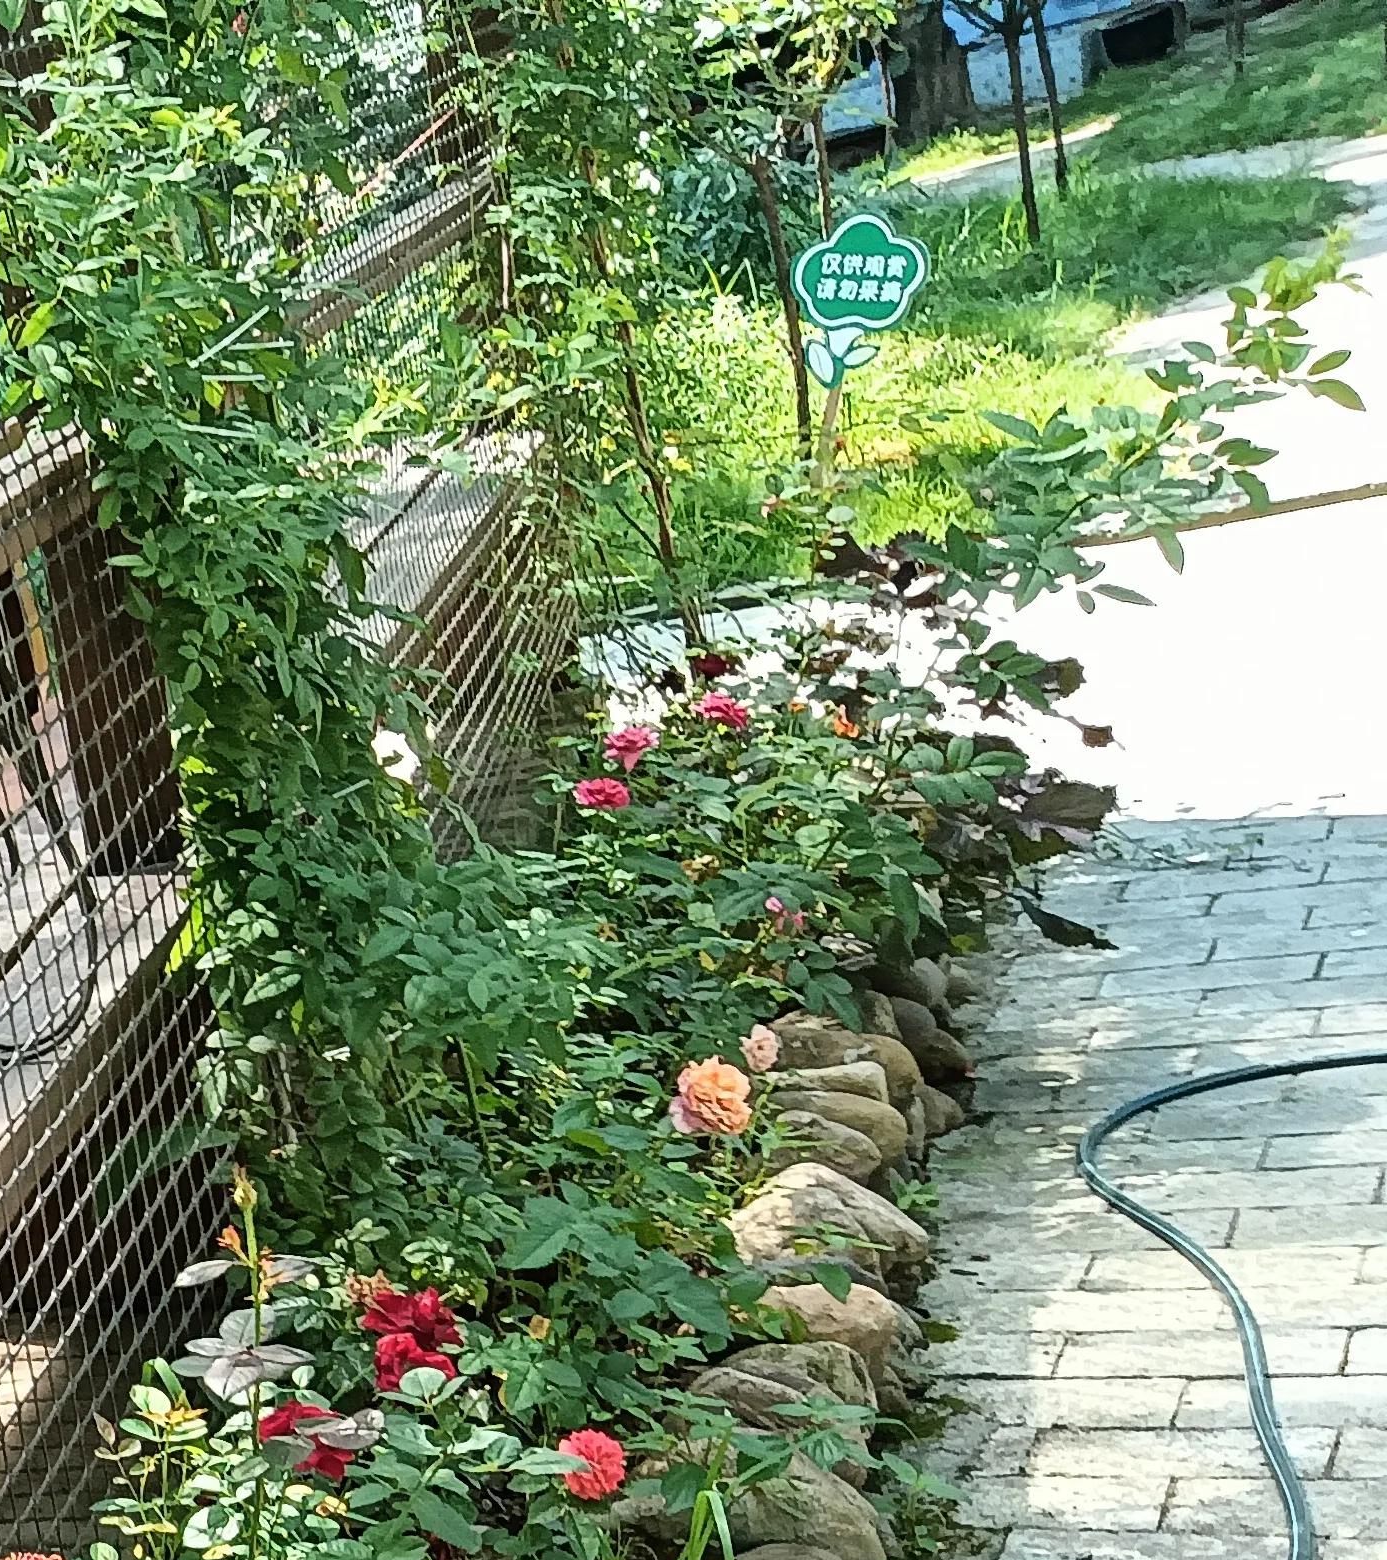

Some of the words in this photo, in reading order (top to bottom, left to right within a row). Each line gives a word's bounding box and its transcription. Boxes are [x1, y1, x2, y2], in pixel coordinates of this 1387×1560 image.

[821, 252, 908, 279] 仅供观赏
[816, 277, 903, 303] 请勿采摘
